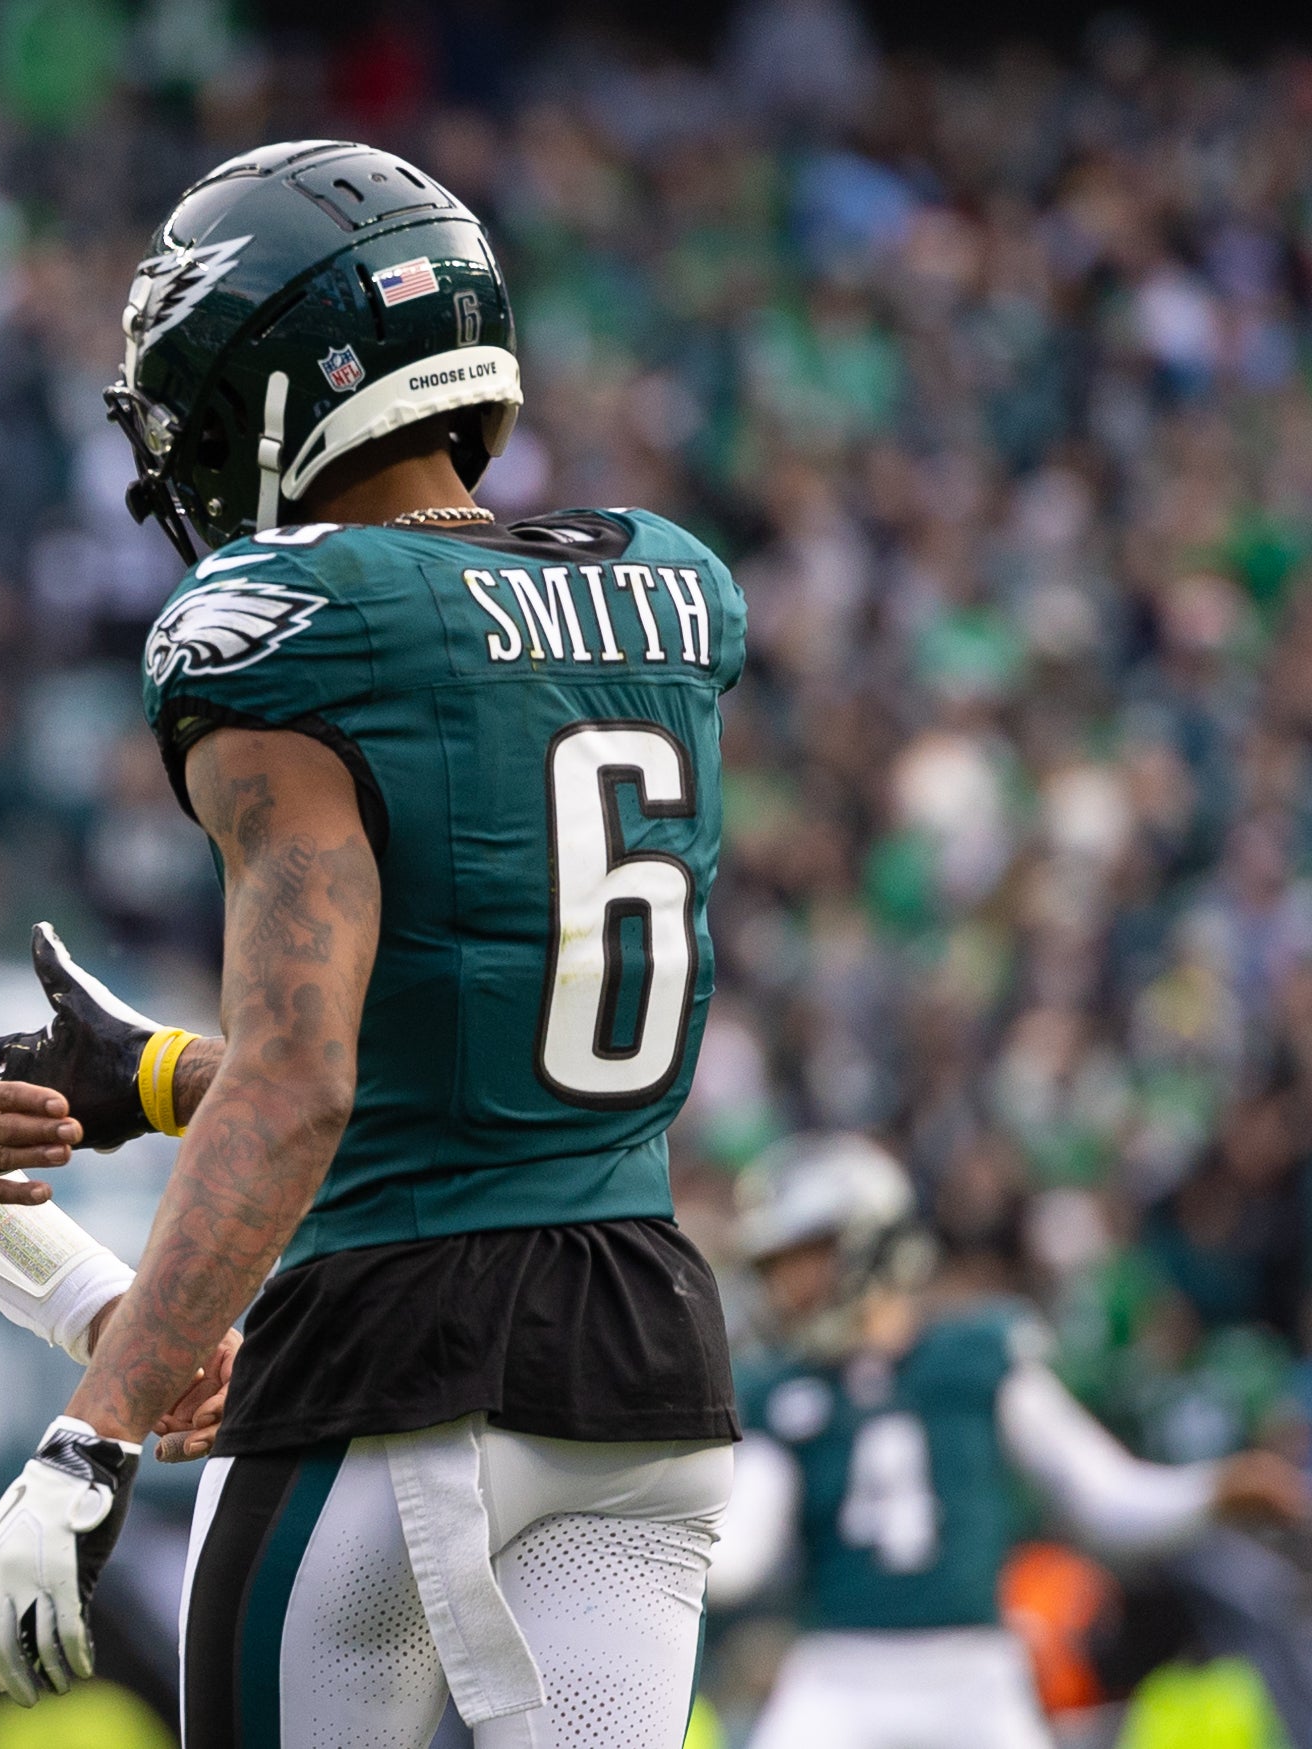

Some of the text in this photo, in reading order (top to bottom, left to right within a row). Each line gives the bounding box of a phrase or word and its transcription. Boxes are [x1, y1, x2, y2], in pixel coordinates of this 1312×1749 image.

[454, 289, 481, 347] 6
[331, 363, 360, 386] NFL
[409, 361, 497, 391] CHOOSE LOVE
[463, 564, 712, 667] SMITH
[535, 719, 696, 1111] 6
